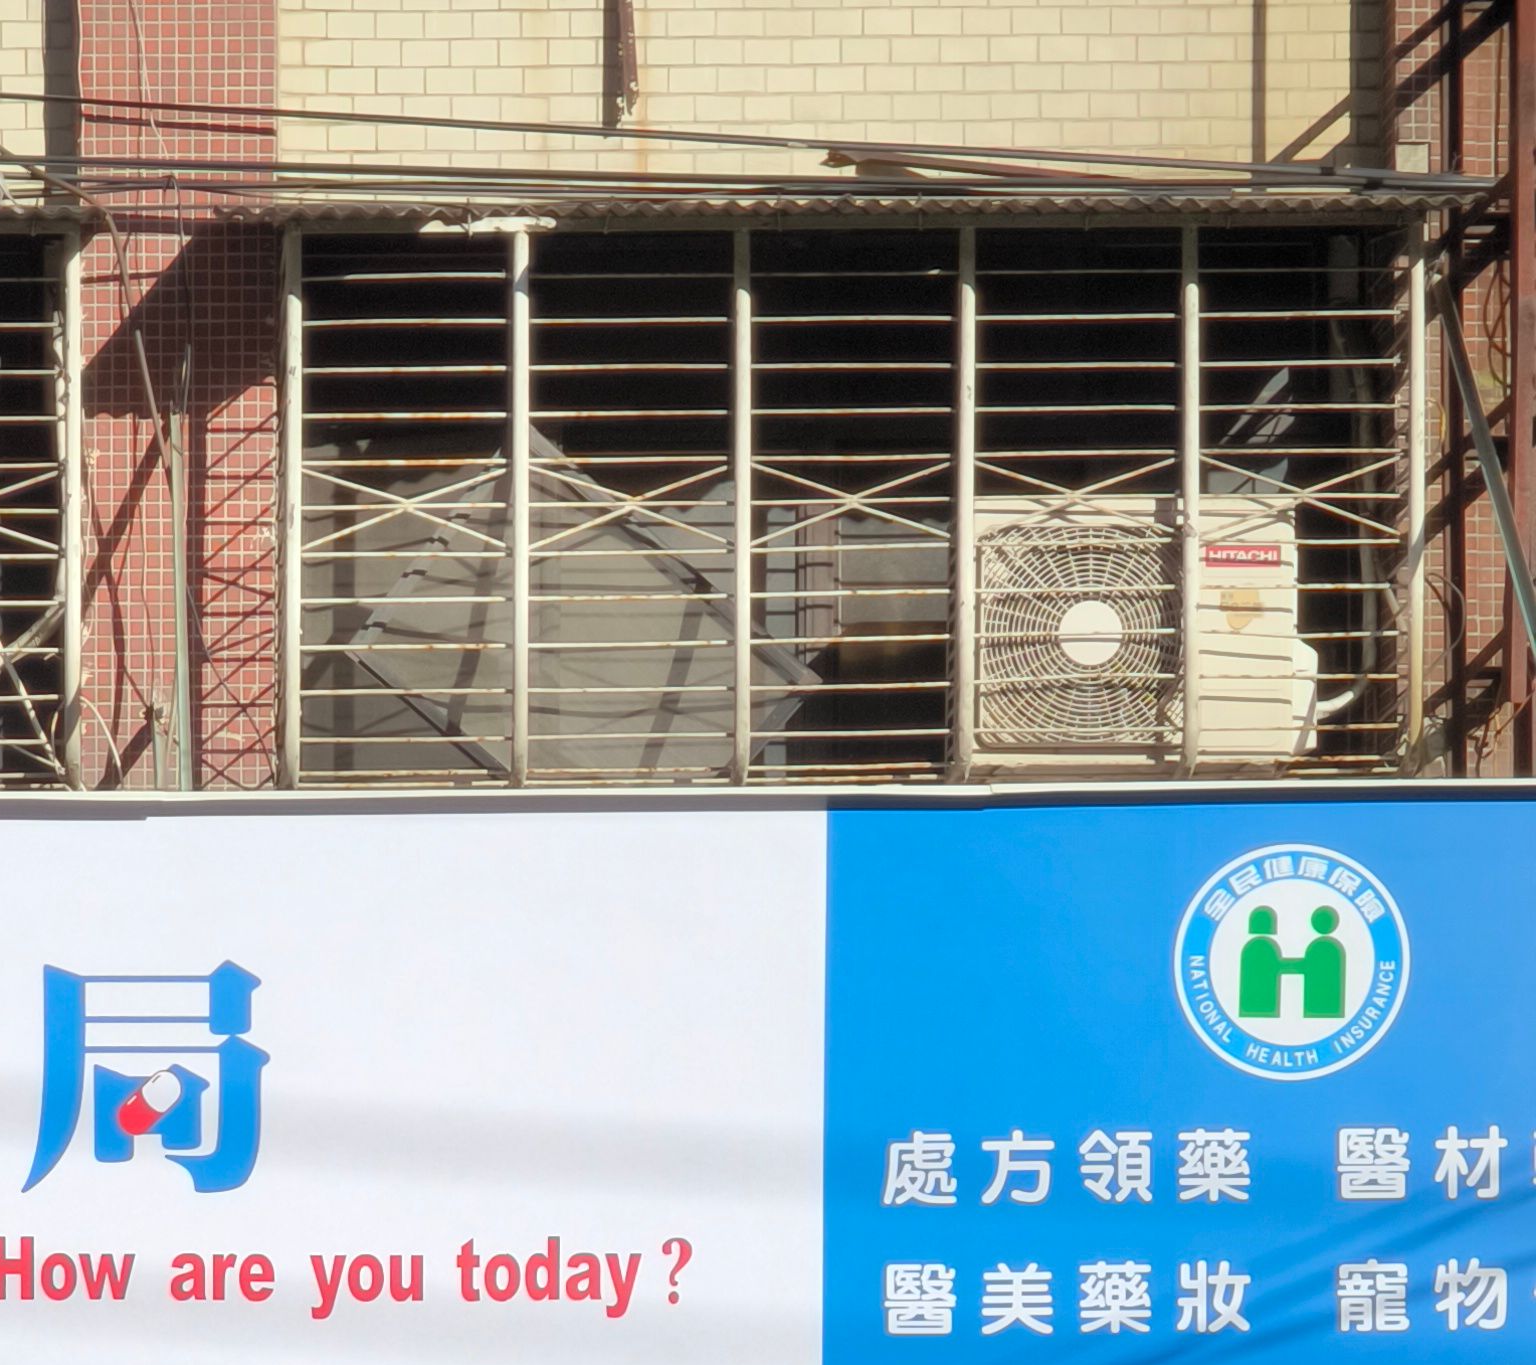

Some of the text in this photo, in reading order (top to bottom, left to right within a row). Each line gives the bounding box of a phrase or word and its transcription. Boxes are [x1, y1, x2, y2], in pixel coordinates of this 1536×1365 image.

[1208, 550, 1278, 562] HITACHI
[1203, 855, 1385, 924] 全民健康保險
[1188, 955, 1397, 1068] NATIONAL HEALTH INSURANCE
[882, 1125, 1536, 1206] 處方領藥 醫材
[169, 1250, 276, 1303] are
[310, 1251, 425, 1320] you
[883, 1258, 1536, 1336] 醫美藥妝 寵物
